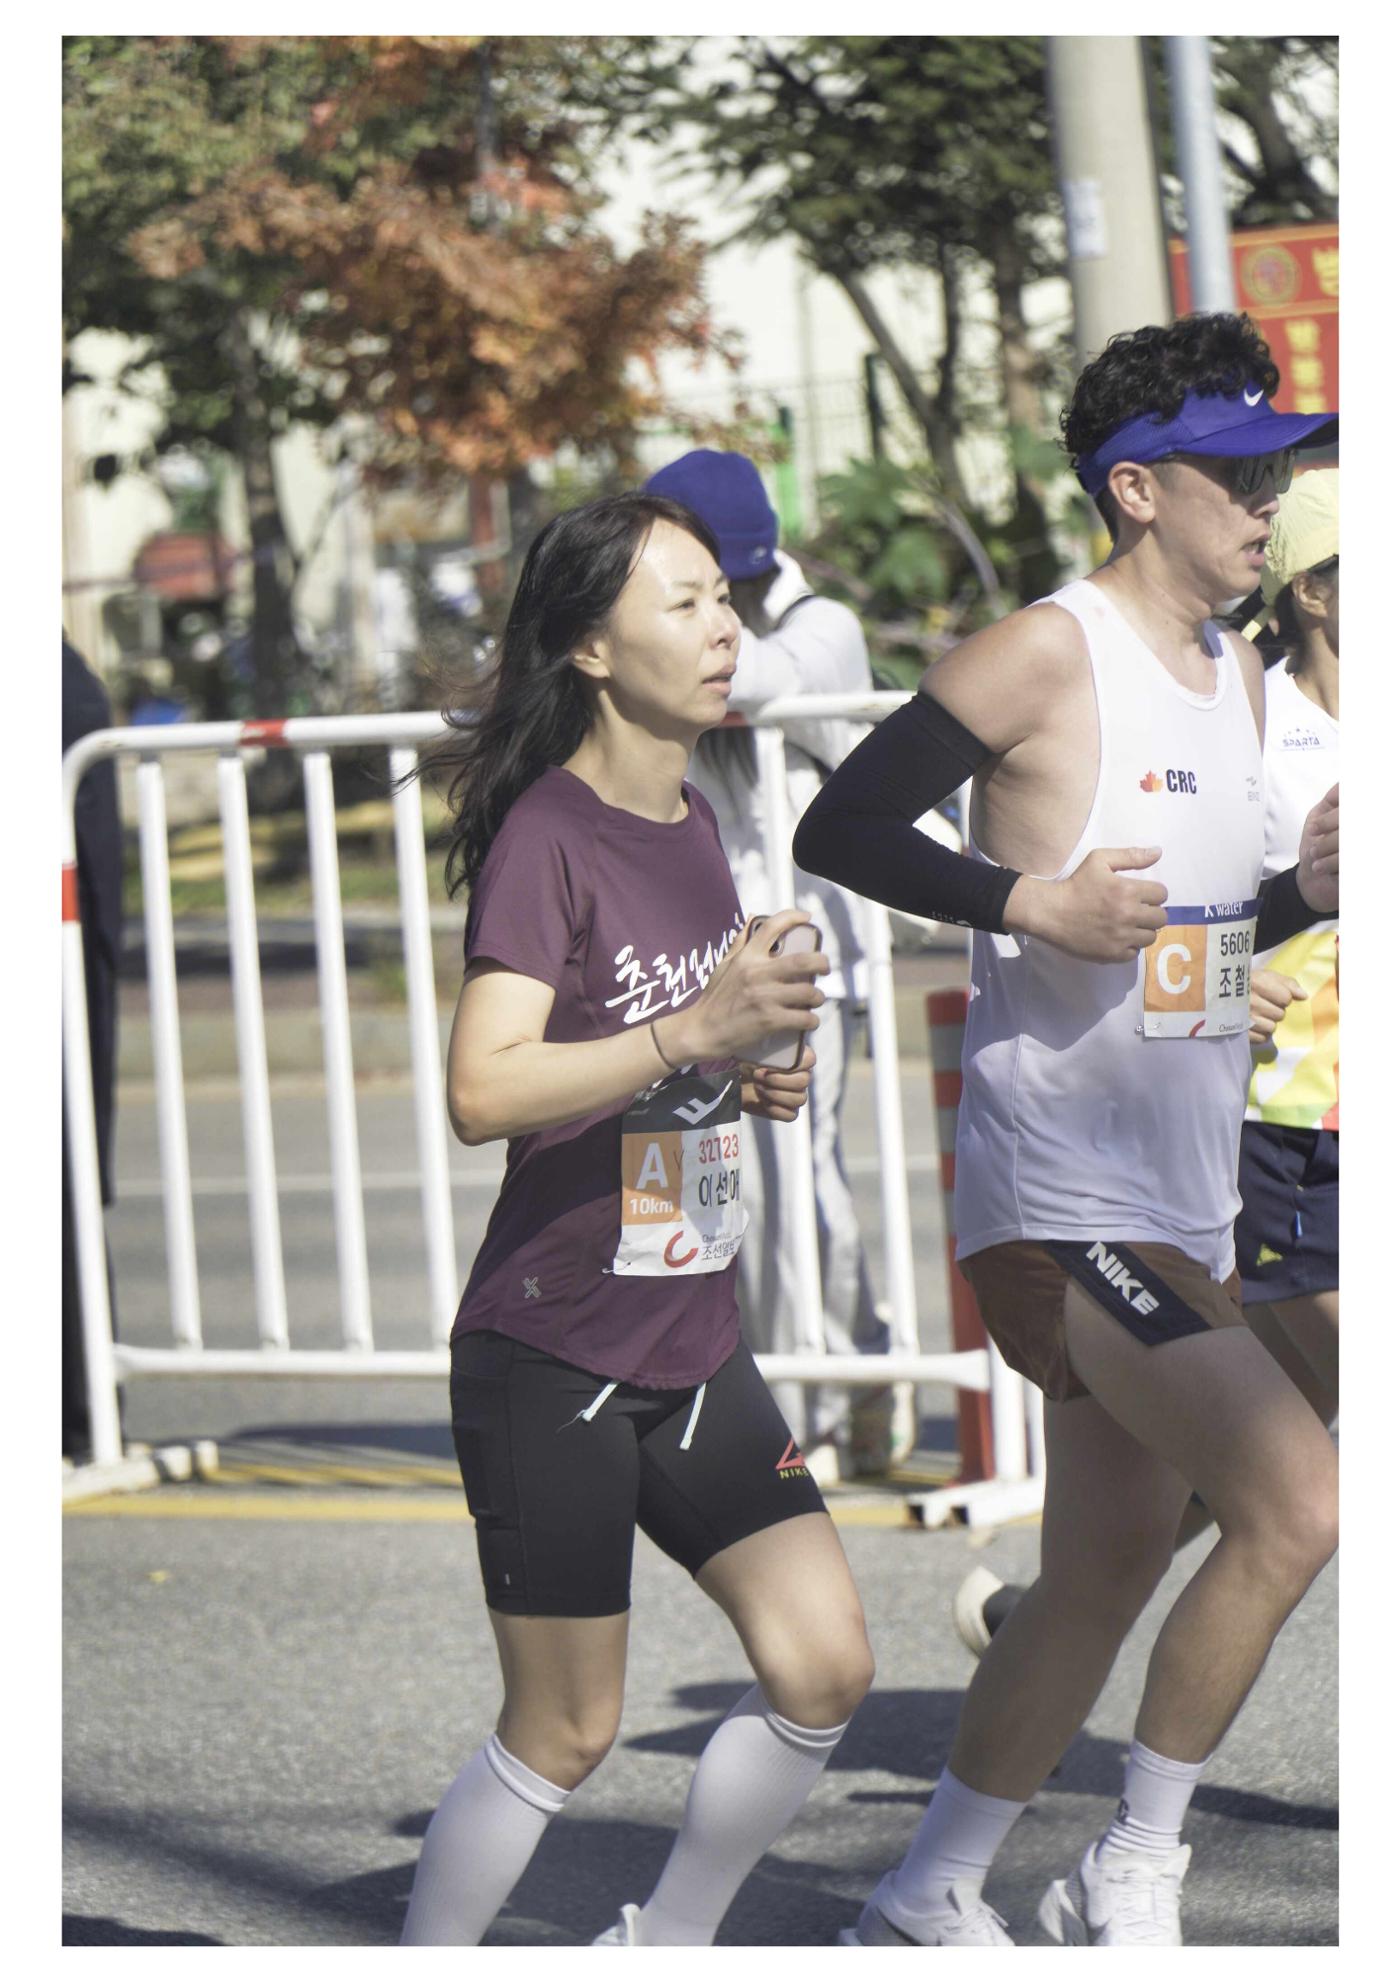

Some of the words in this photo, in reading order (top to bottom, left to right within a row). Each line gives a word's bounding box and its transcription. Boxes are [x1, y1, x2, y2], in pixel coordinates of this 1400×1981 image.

[1166, 769, 1197, 794] CRC
[1216, 901, 1243, 917] water
[1220, 931, 1250, 956] 5606
[1157, 944, 1191, 994] C
[1219, 965, 1250, 998] 조철
[698, 1133, 739, 1164] 32723
[635, 1142, 669, 1190] A
[629, 1197, 673, 1215] 10km
[1086, 1241, 1160, 1316] NIKE
